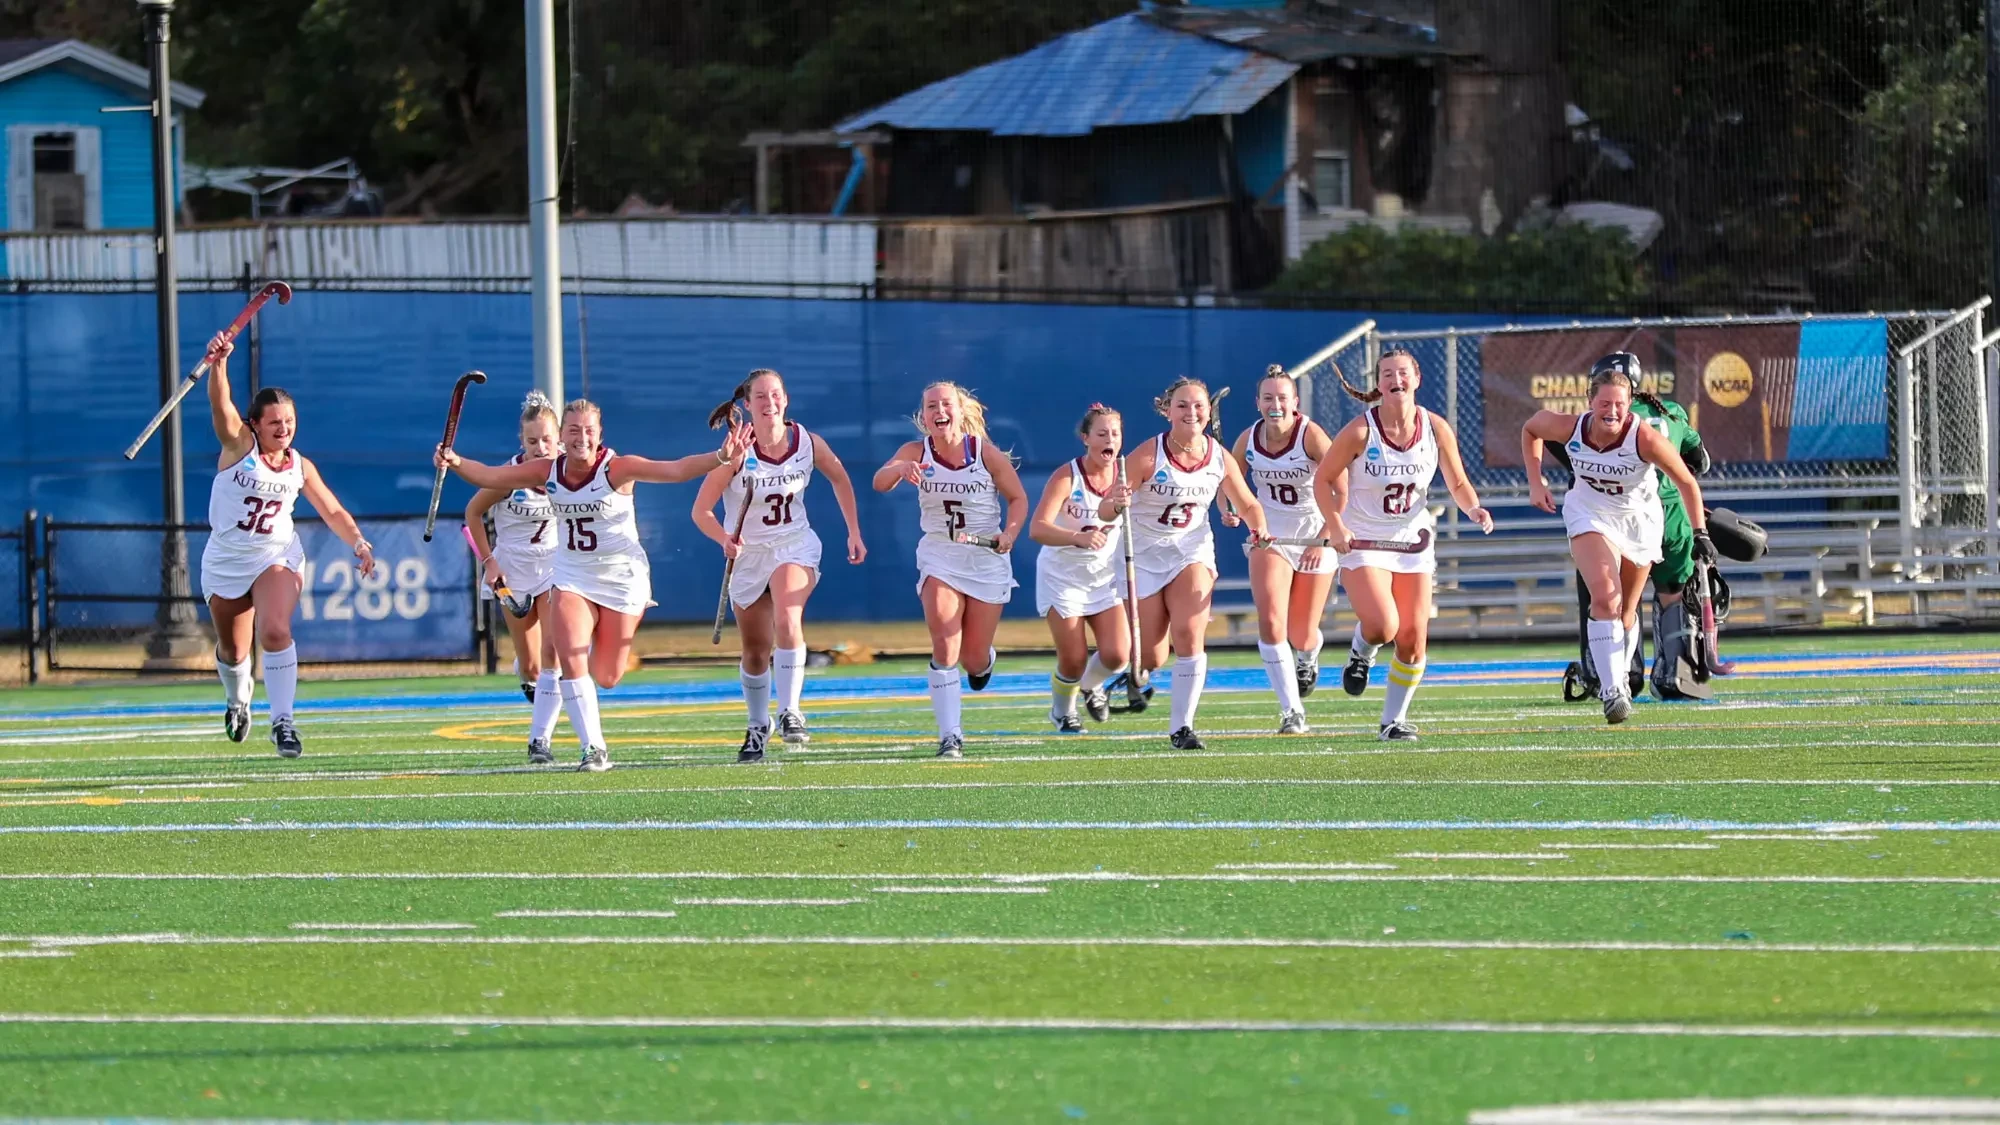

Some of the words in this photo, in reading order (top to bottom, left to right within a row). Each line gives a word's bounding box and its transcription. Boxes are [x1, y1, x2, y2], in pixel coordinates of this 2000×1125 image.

[1531, 372, 1675, 398] CHAMNS
[1711, 379, 1750, 394] NCAA
[1256, 465, 1311, 480] TZTOWN
[1364, 461, 1425, 477] KUTZTOW
[1571, 457, 1637, 476] UTZTOWN
[232, 470, 292, 494] KUTZTOW
[920, 480, 989, 494] KUTZTOWN
[1150, 483, 1209, 497] KUTZTOW
[507, 501, 554, 517] KUTZT
[762, 491, 794, 526] 31
[1383, 482, 1416, 515] 21
[236, 496, 283, 535] 32
[943, 500, 967, 530] 5
[1067, 504, 1099, 520] KUTZ
[530, 519, 548, 544] 7
[566, 517, 598, 552] 15
[300, 558, 430, 620] 1288
